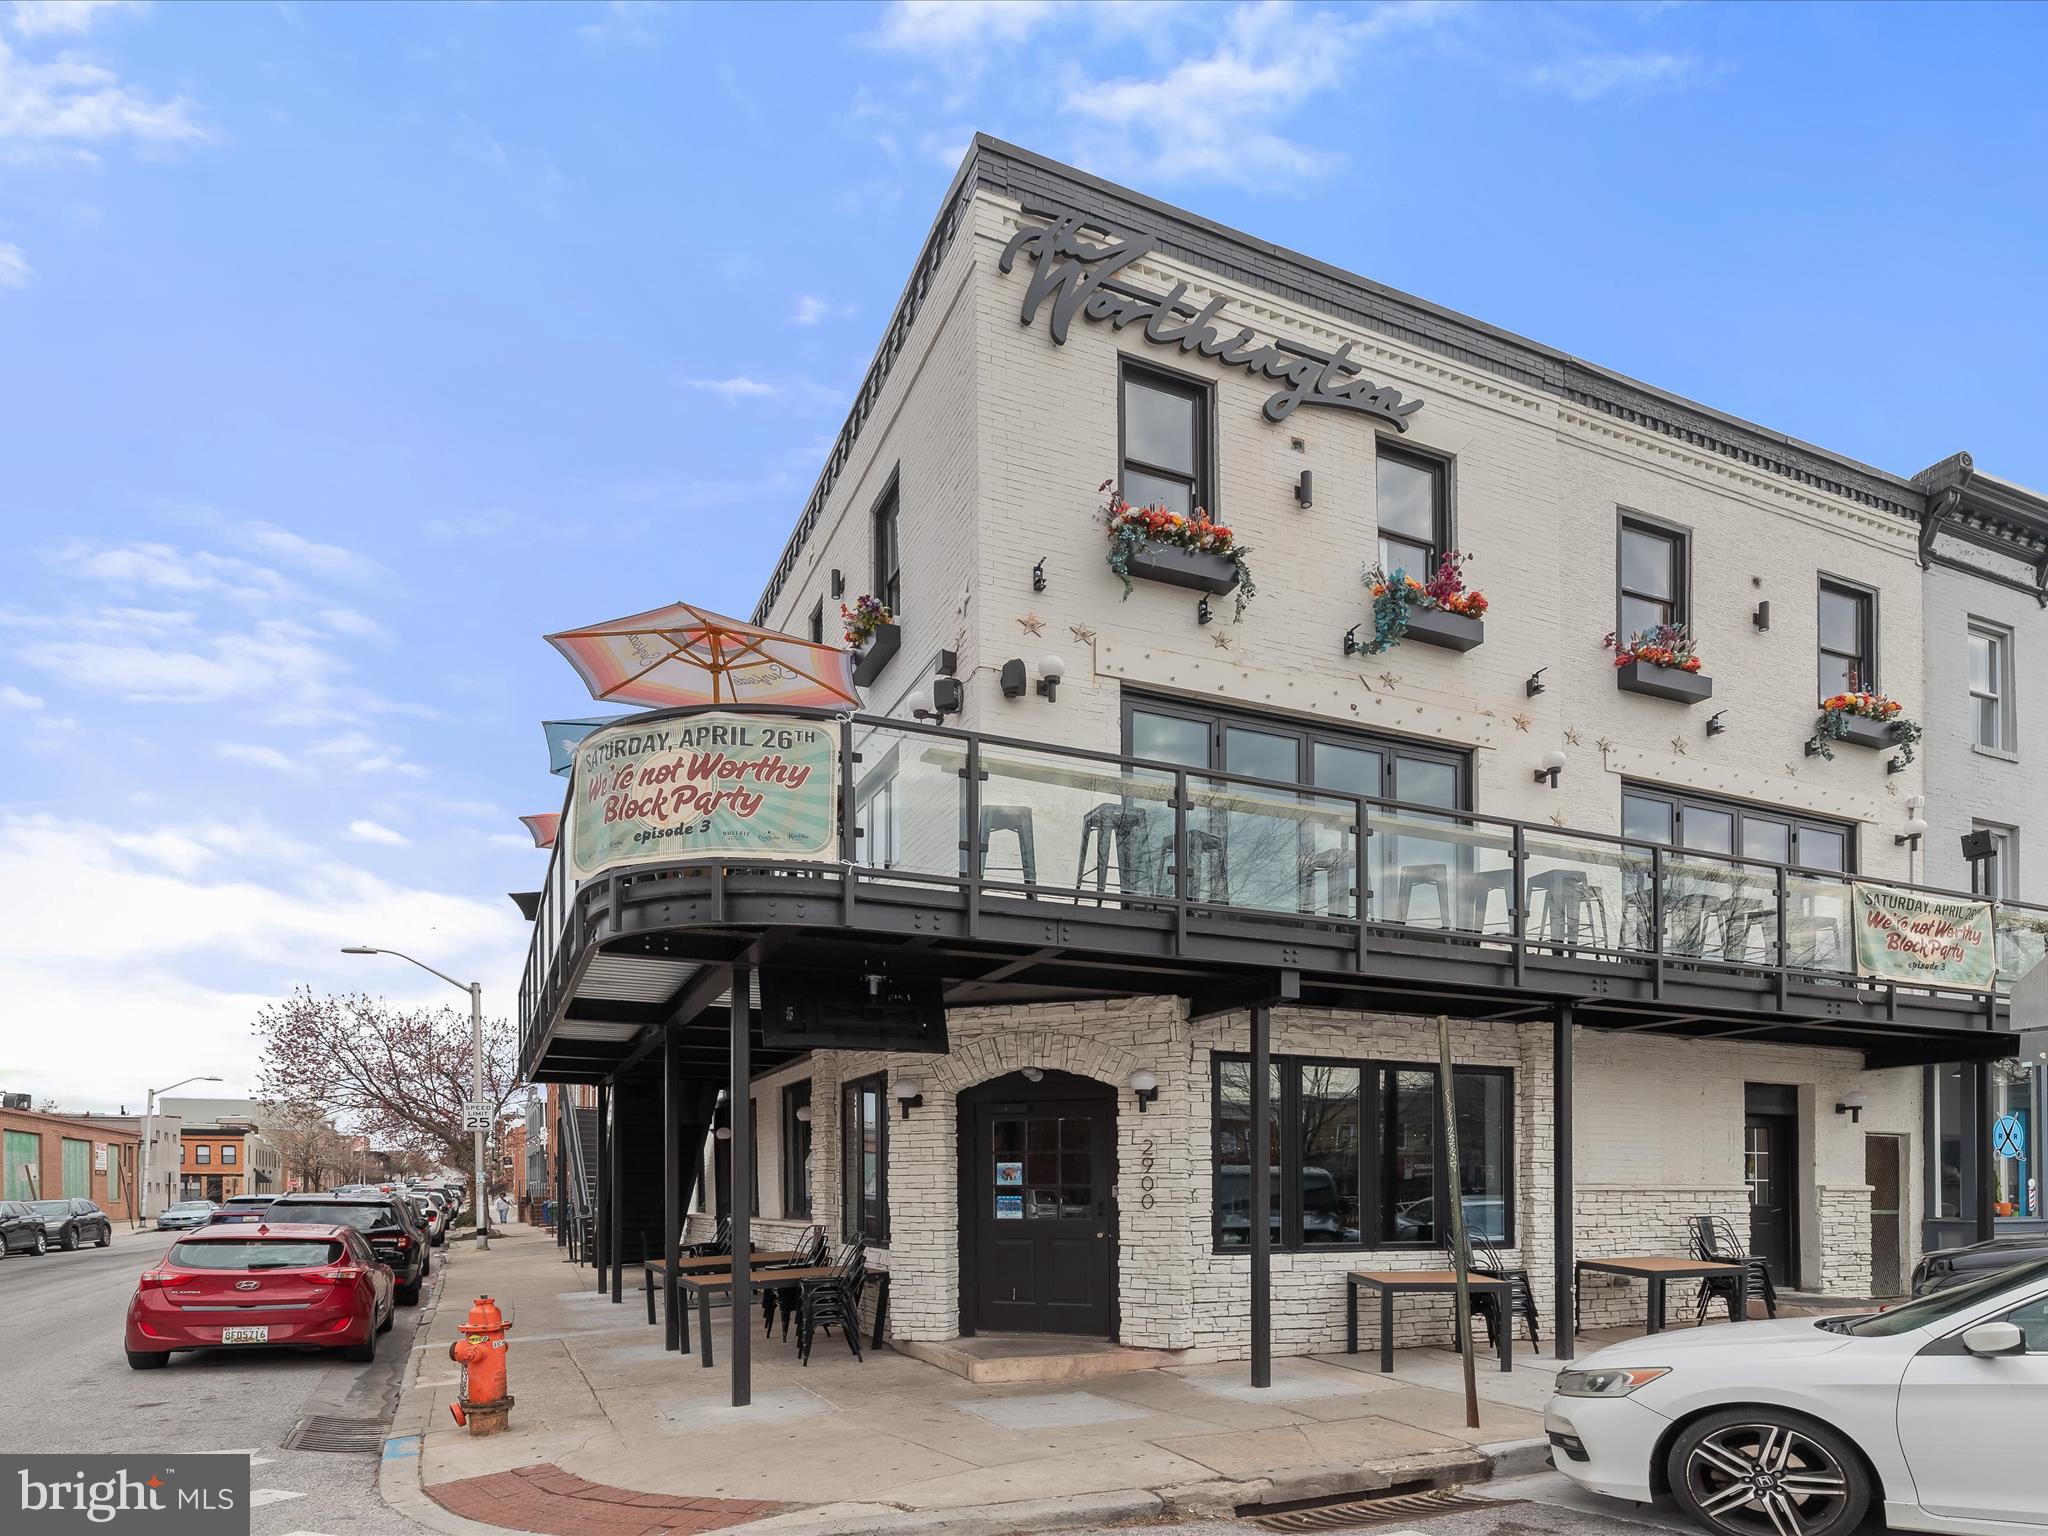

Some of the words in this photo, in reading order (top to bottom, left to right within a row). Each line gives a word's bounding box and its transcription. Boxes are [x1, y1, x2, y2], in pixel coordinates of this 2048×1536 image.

[999, 227, 1425, 433] Worthington
[585, 731, 672, 772] SATURDAY,
[679, 725, 753, 749] APRIL
[588, 762, 635, 804] We're
[637, 756, 685, 788] not
[686, 751, 812, 790] Worthy
[603, 787, 669, 825] Block
[670, 784, 764, 819] Party
[633, 821, 694, 845] episode
[699, 819, 711, 834] 3
[1864, 892, 1931, 916] SATURDAY,
[1934, 903, 1963, 920] APRIL
[1886, 931, 1929, 959] Block
[1929, 939, 1966, 963] Party
[1910, 919, 1936, 937] not
[1935, 920, 1982, 946] Worthy
[1908, 960, 1938, 971] episode
[1940, 962, 1946, 971] 3
[467, 1117, 490, 1128] 25
[1142, 1139, 1154, 1209] 2900
